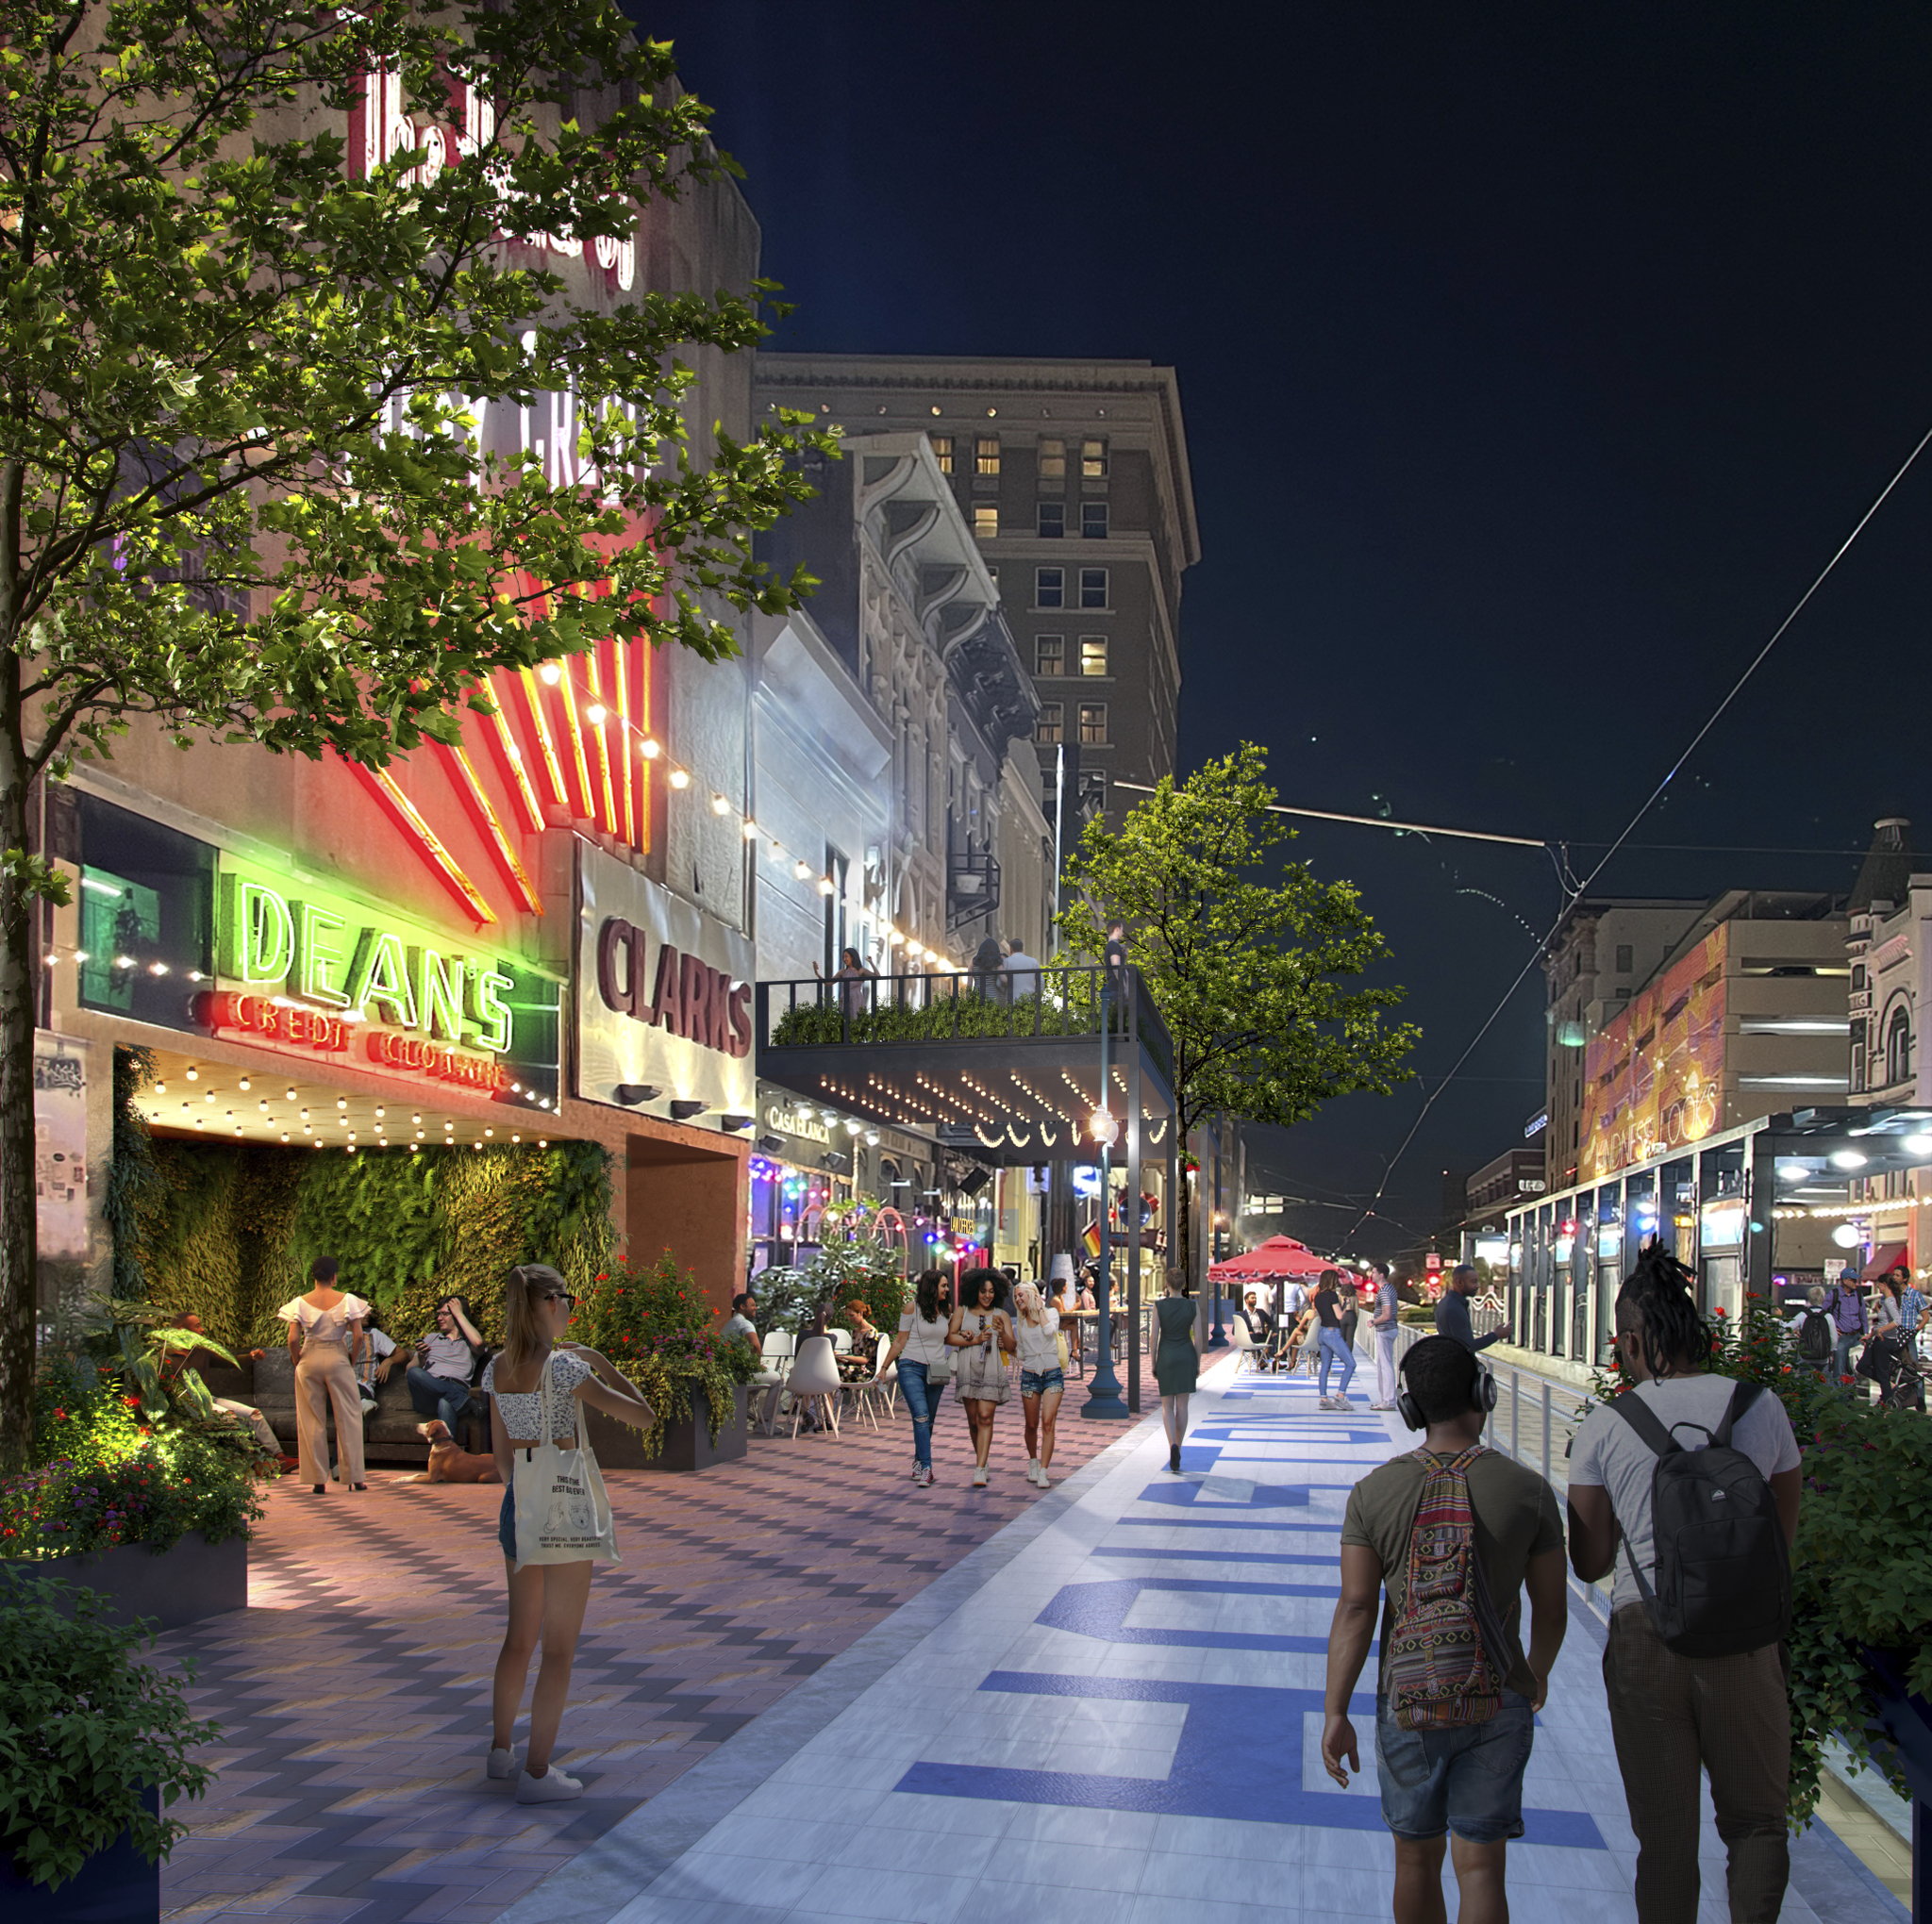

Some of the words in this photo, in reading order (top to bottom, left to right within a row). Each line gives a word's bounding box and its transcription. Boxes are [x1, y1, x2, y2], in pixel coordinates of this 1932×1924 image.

[597, 915, 753, 1059] CLARKS
[557, 1475, 569, 1484] THIS
[552, 1484, 565, 1493] BEST
[573, 1487, 586, 1496] EVER
